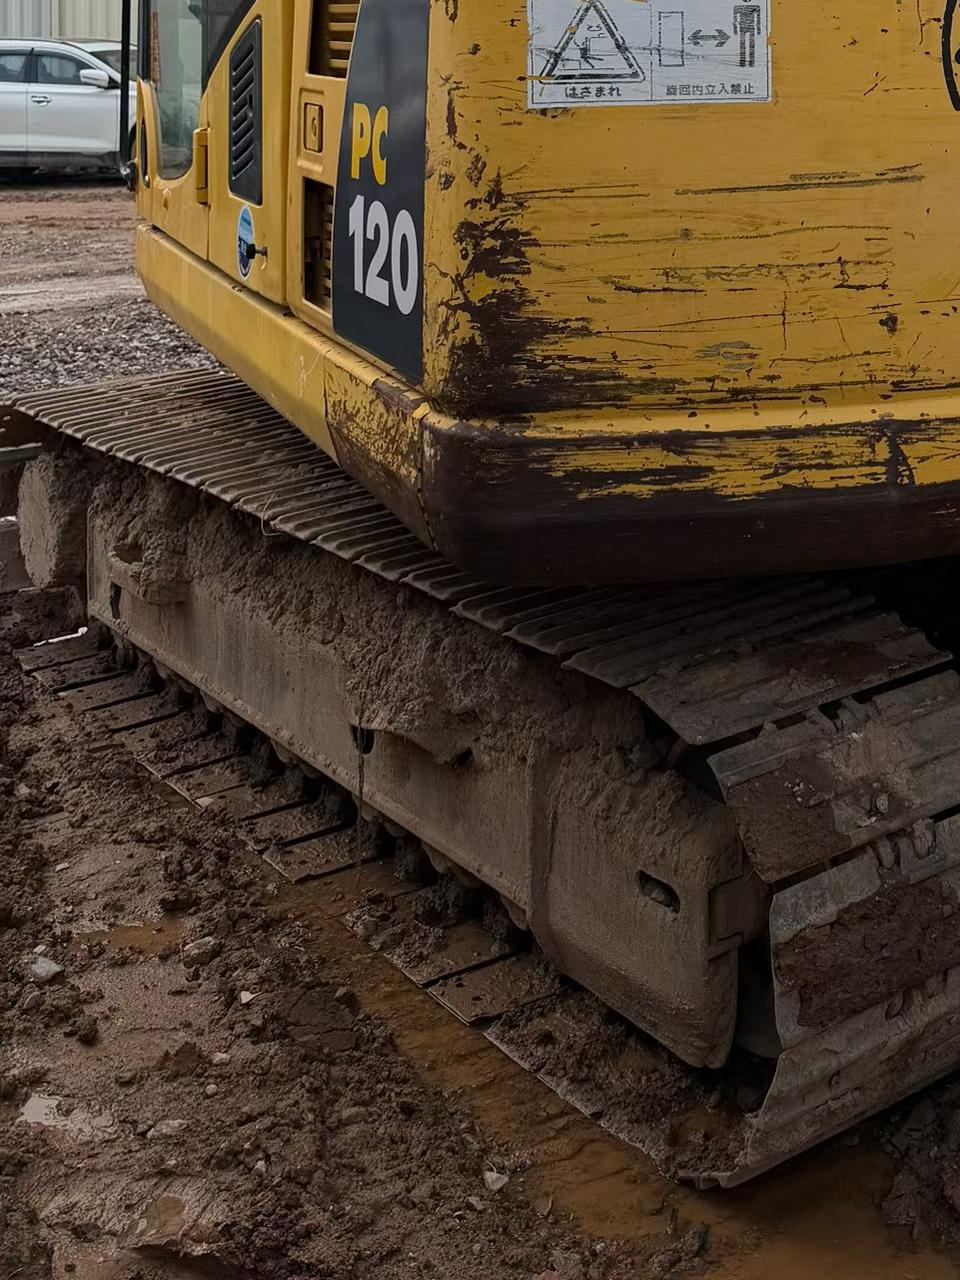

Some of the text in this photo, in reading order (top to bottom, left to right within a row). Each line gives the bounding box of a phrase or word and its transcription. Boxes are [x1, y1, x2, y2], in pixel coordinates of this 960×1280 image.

[564, 85, 622, 99] はさまれ
[665, 82, 755, 96] 旋回内立入禁止
[350, 102, 388, 186] PC
[349, 194, 418, 316] 120
